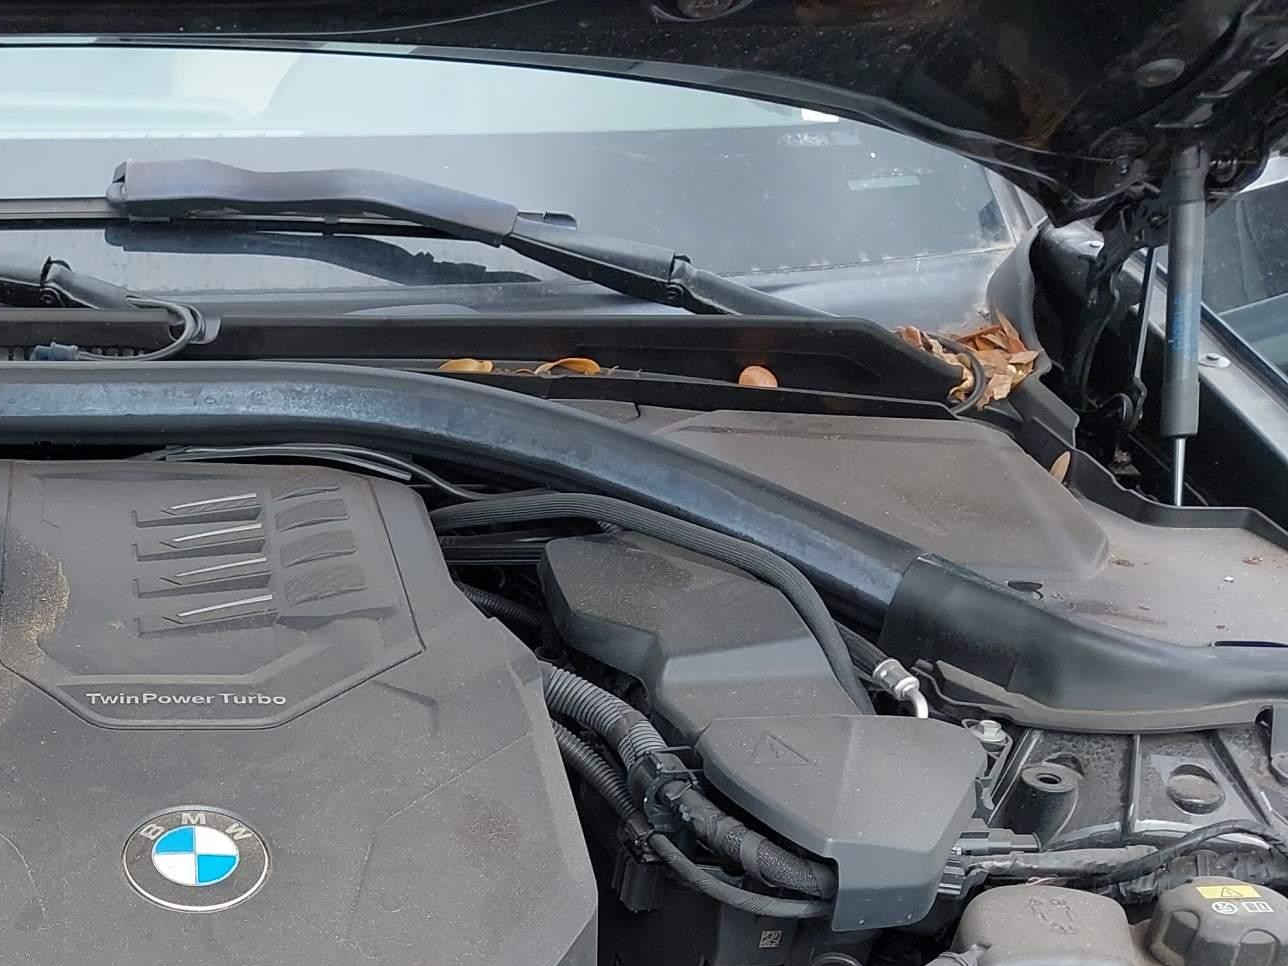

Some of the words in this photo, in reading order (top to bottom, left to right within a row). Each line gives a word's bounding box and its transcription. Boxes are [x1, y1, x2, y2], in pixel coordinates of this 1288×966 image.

[85, 692, 215, 705] TwinPower
[218, 692, 286, 705] Turbo
[140, 812, 253, 841] BMW
